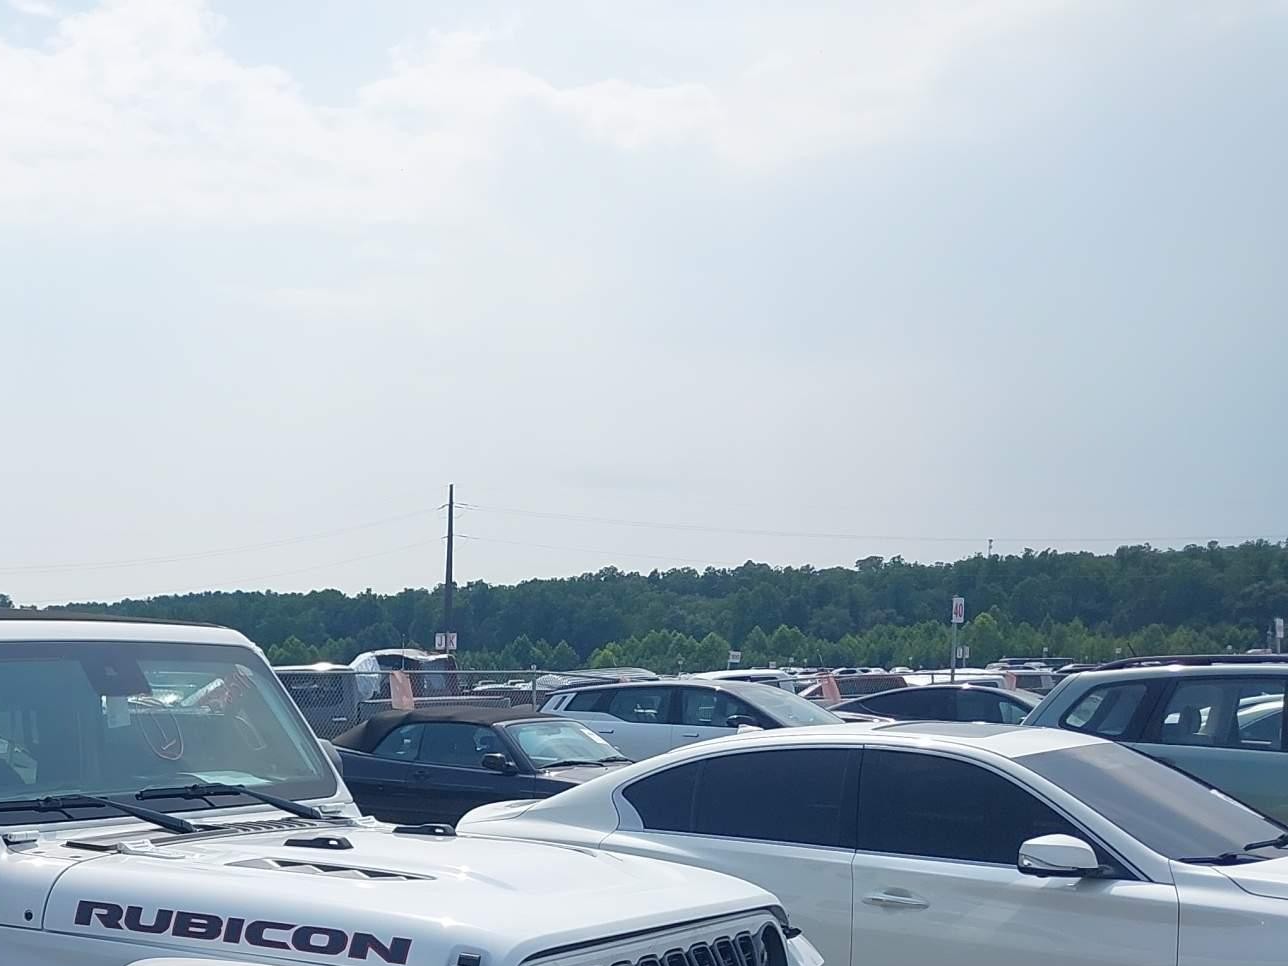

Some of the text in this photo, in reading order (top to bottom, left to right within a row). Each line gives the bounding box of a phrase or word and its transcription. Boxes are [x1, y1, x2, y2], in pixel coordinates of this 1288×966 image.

[953, 603, 964, 618] 40
[437, 635, 455, 647] J K
[74, 900, 413, 965] RUBICON
